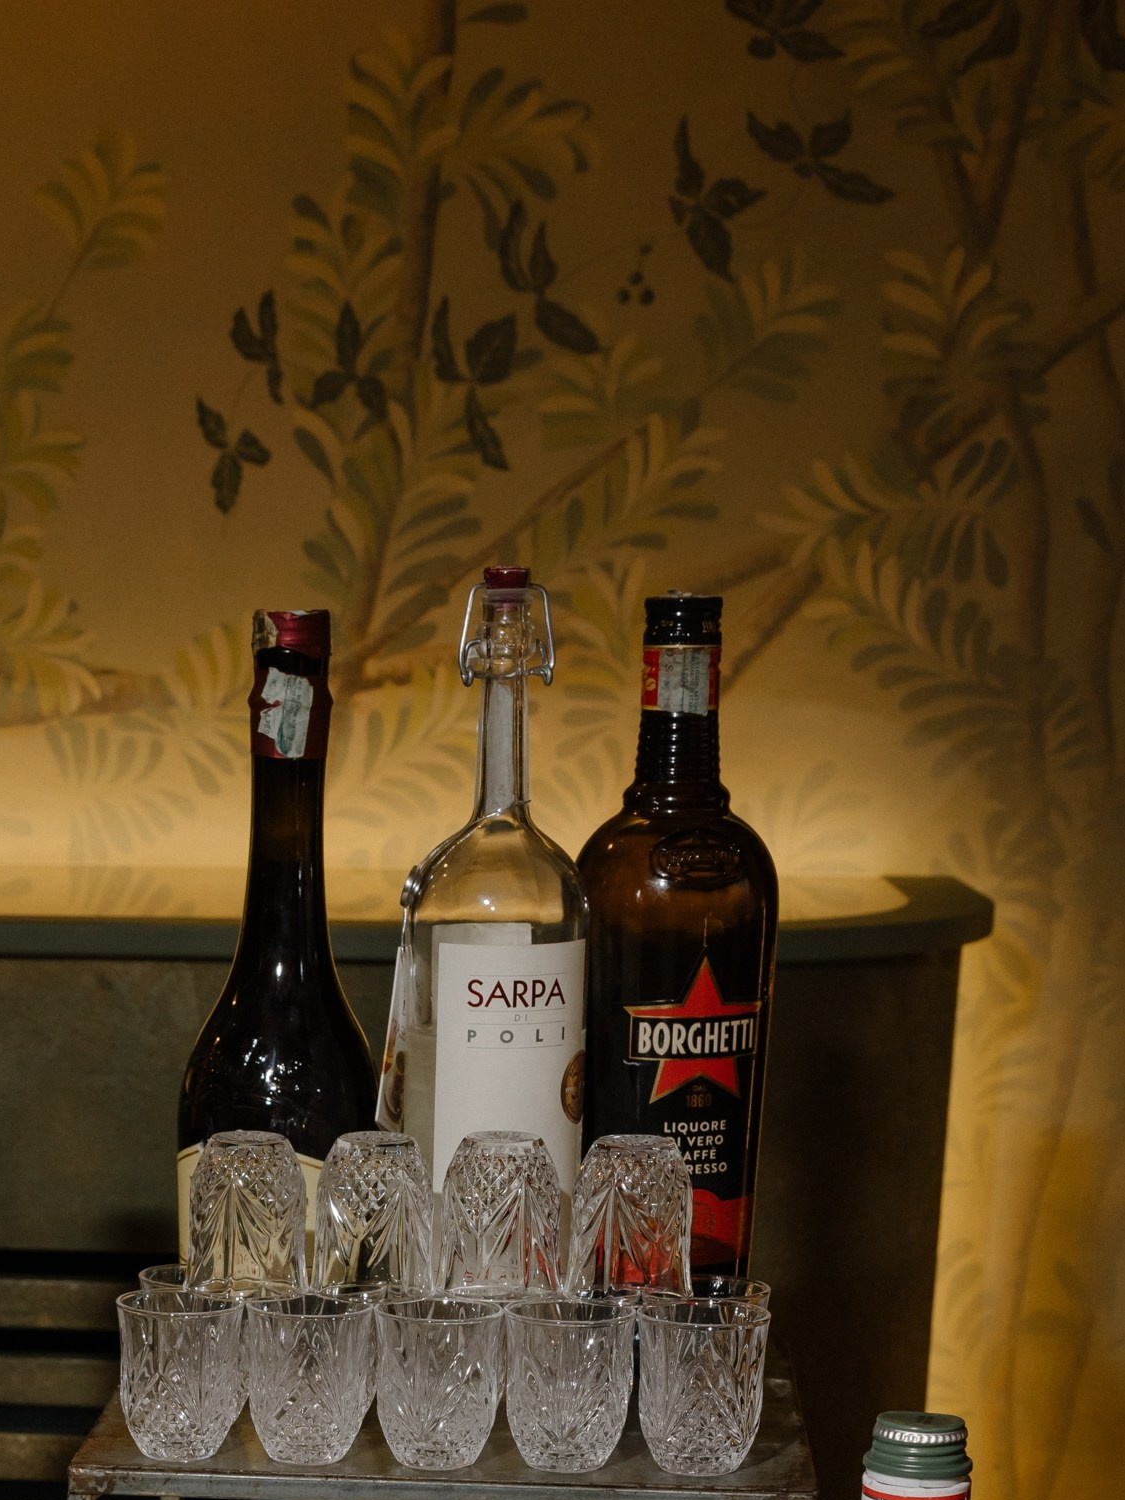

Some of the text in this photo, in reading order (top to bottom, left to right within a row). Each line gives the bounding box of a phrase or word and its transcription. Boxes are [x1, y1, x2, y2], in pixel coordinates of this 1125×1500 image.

[467, 977, 566, 1009] SARPA
[514, 1013, 528, 1022] DI
[467, 1026, 566, 1044] POLI
[637, 1018, 755, 1055] BORGHETTI
[686, 1094, 713, 1108] 1860
[663, 1120, 727, 1135] LIQUORE
[687, 1135, 724, 1147] VERO
[683, 1146, 716, 1161] AFFÈ
[686, 1162, 727, 1175] RESSO
